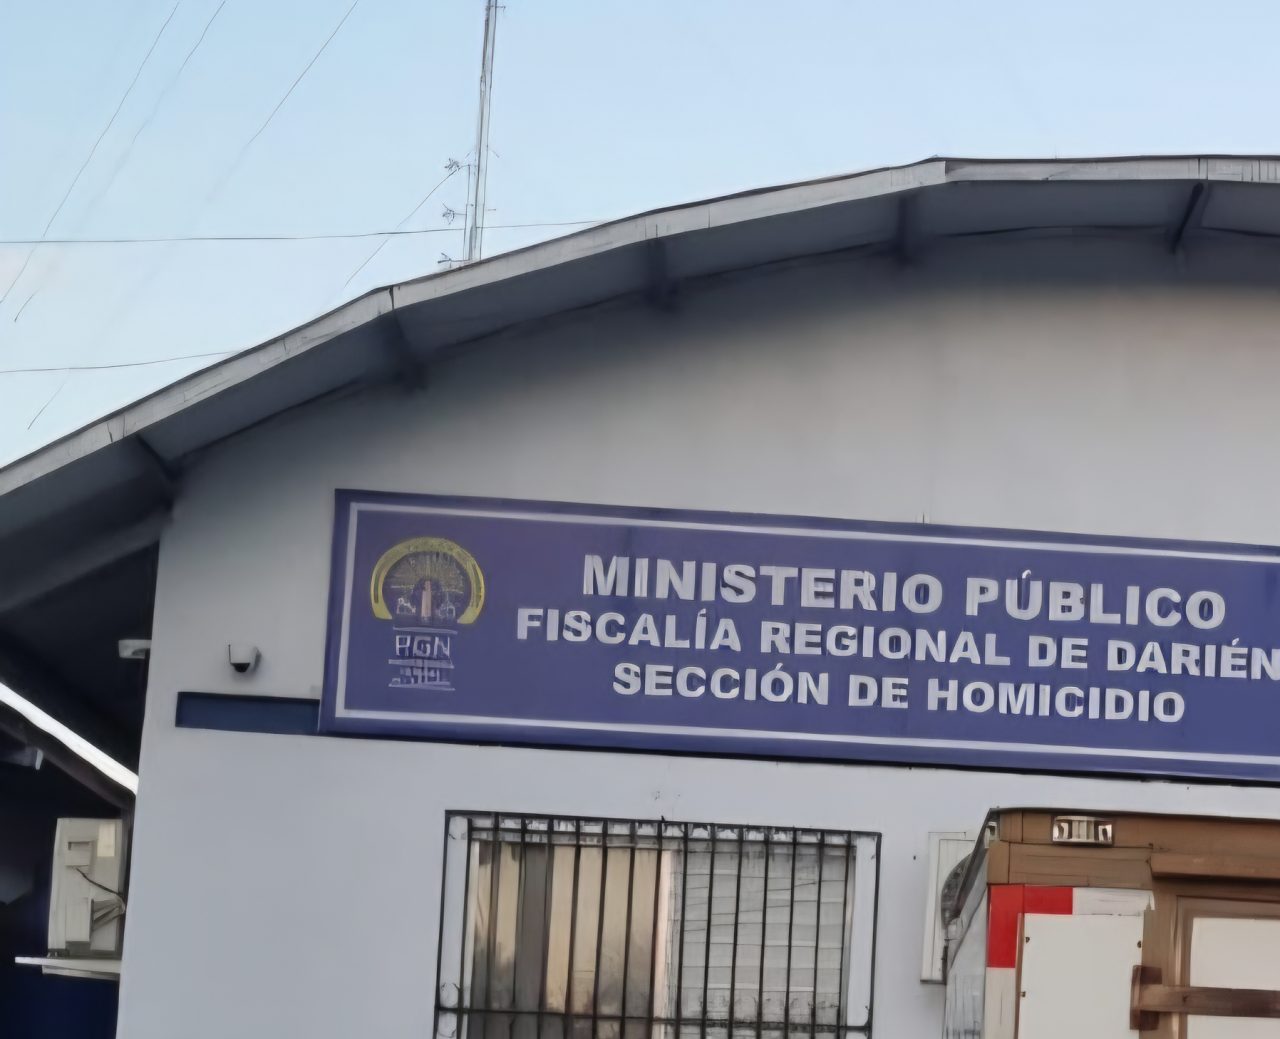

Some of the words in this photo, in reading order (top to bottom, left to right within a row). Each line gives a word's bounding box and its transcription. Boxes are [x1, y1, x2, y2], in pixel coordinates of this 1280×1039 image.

[582, 554, 943, 613] MINISTERIO
[965, 569, 1227, 631] PÚBLICO
[395, 634, 451, 659] PGN
[516, 607, 742, 651] FISCALÍA
[760, 621, 1011, 667] REGIONAL
[1027, 635, 1089, 670] DE
[612, 662, 829, 706] SECCIÓN
[848, 673, 909, 709] DE
[926, 677, 1186, 723] HOMICIDIO
